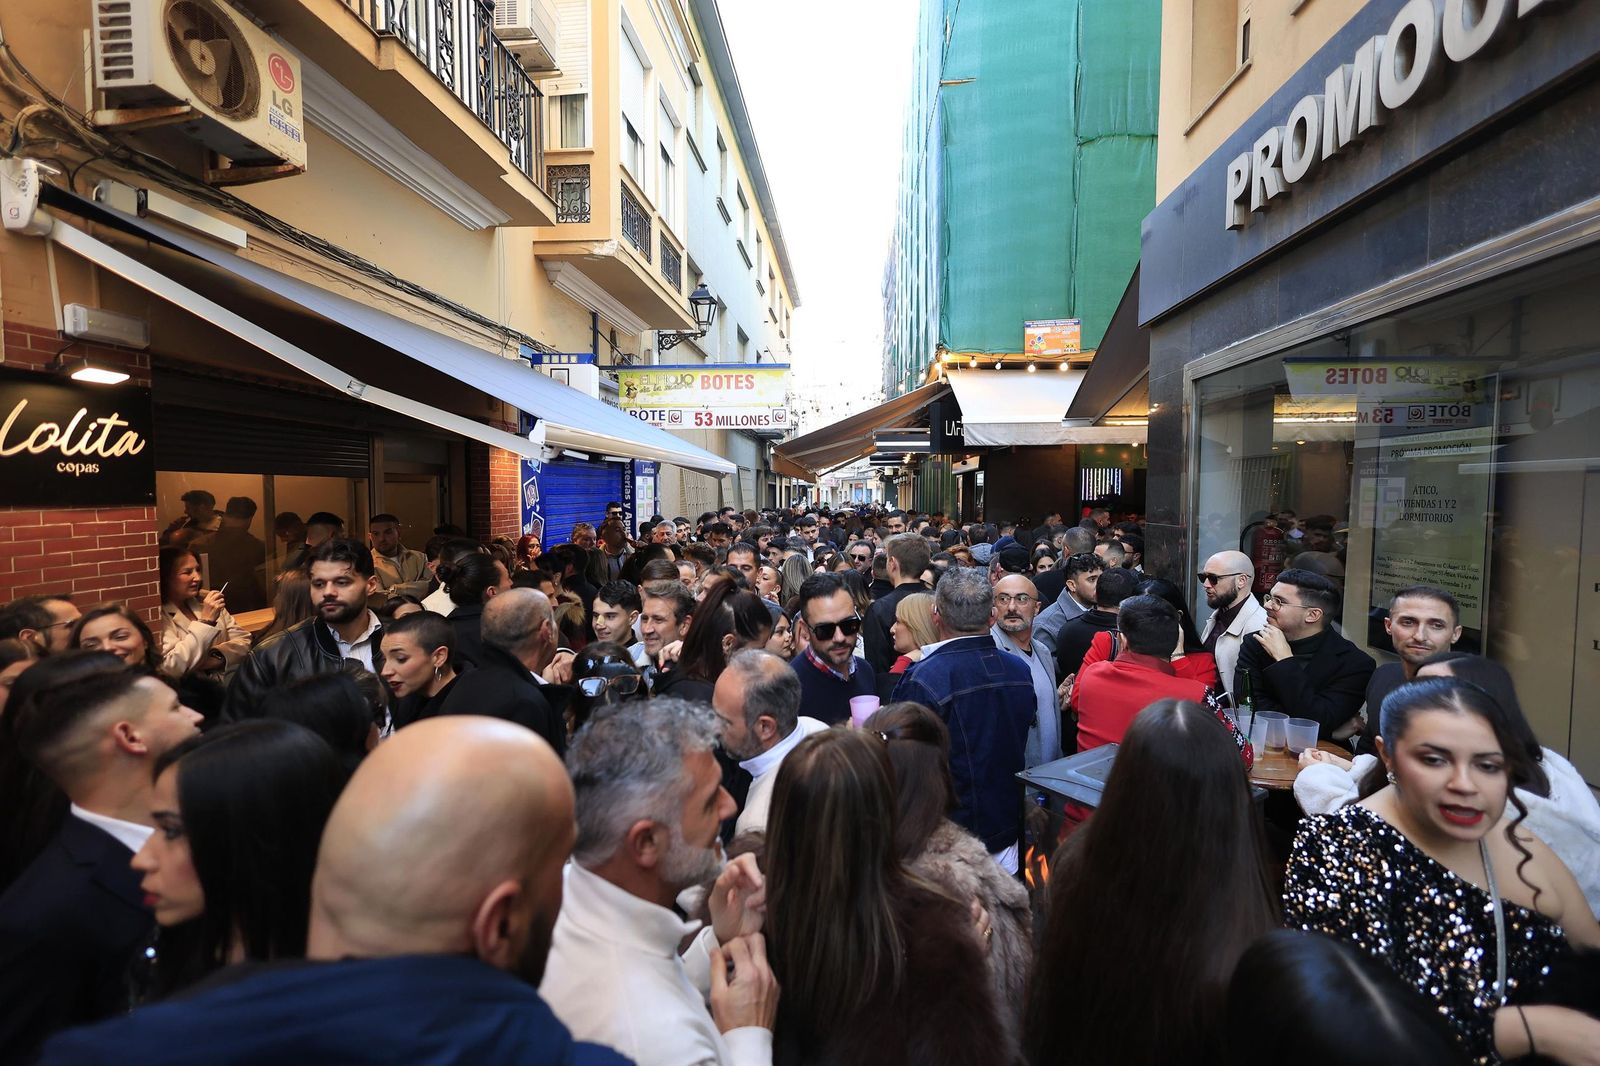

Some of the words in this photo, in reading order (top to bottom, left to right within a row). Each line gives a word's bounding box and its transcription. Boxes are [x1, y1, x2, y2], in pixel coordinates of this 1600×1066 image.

[272, 89, 293, 118] LG
[701, 374, 755, 390] BOTES
[694, 412, 714, 427] 53
[715, 414, 770, 427] MILLONES
[1423, 441, 1473, 455] PROMOCIÓN
[56, 462, 100, 477] copas
[1396, 499, 1436, 508] VIVIENDAS
[1437, 499, 1442, 508] 1
[1444, 499, 1450, 508] Y
[1451, 499, 1457, 508] 2
[1399, 512, 1454, 523] DORMITORIOS
